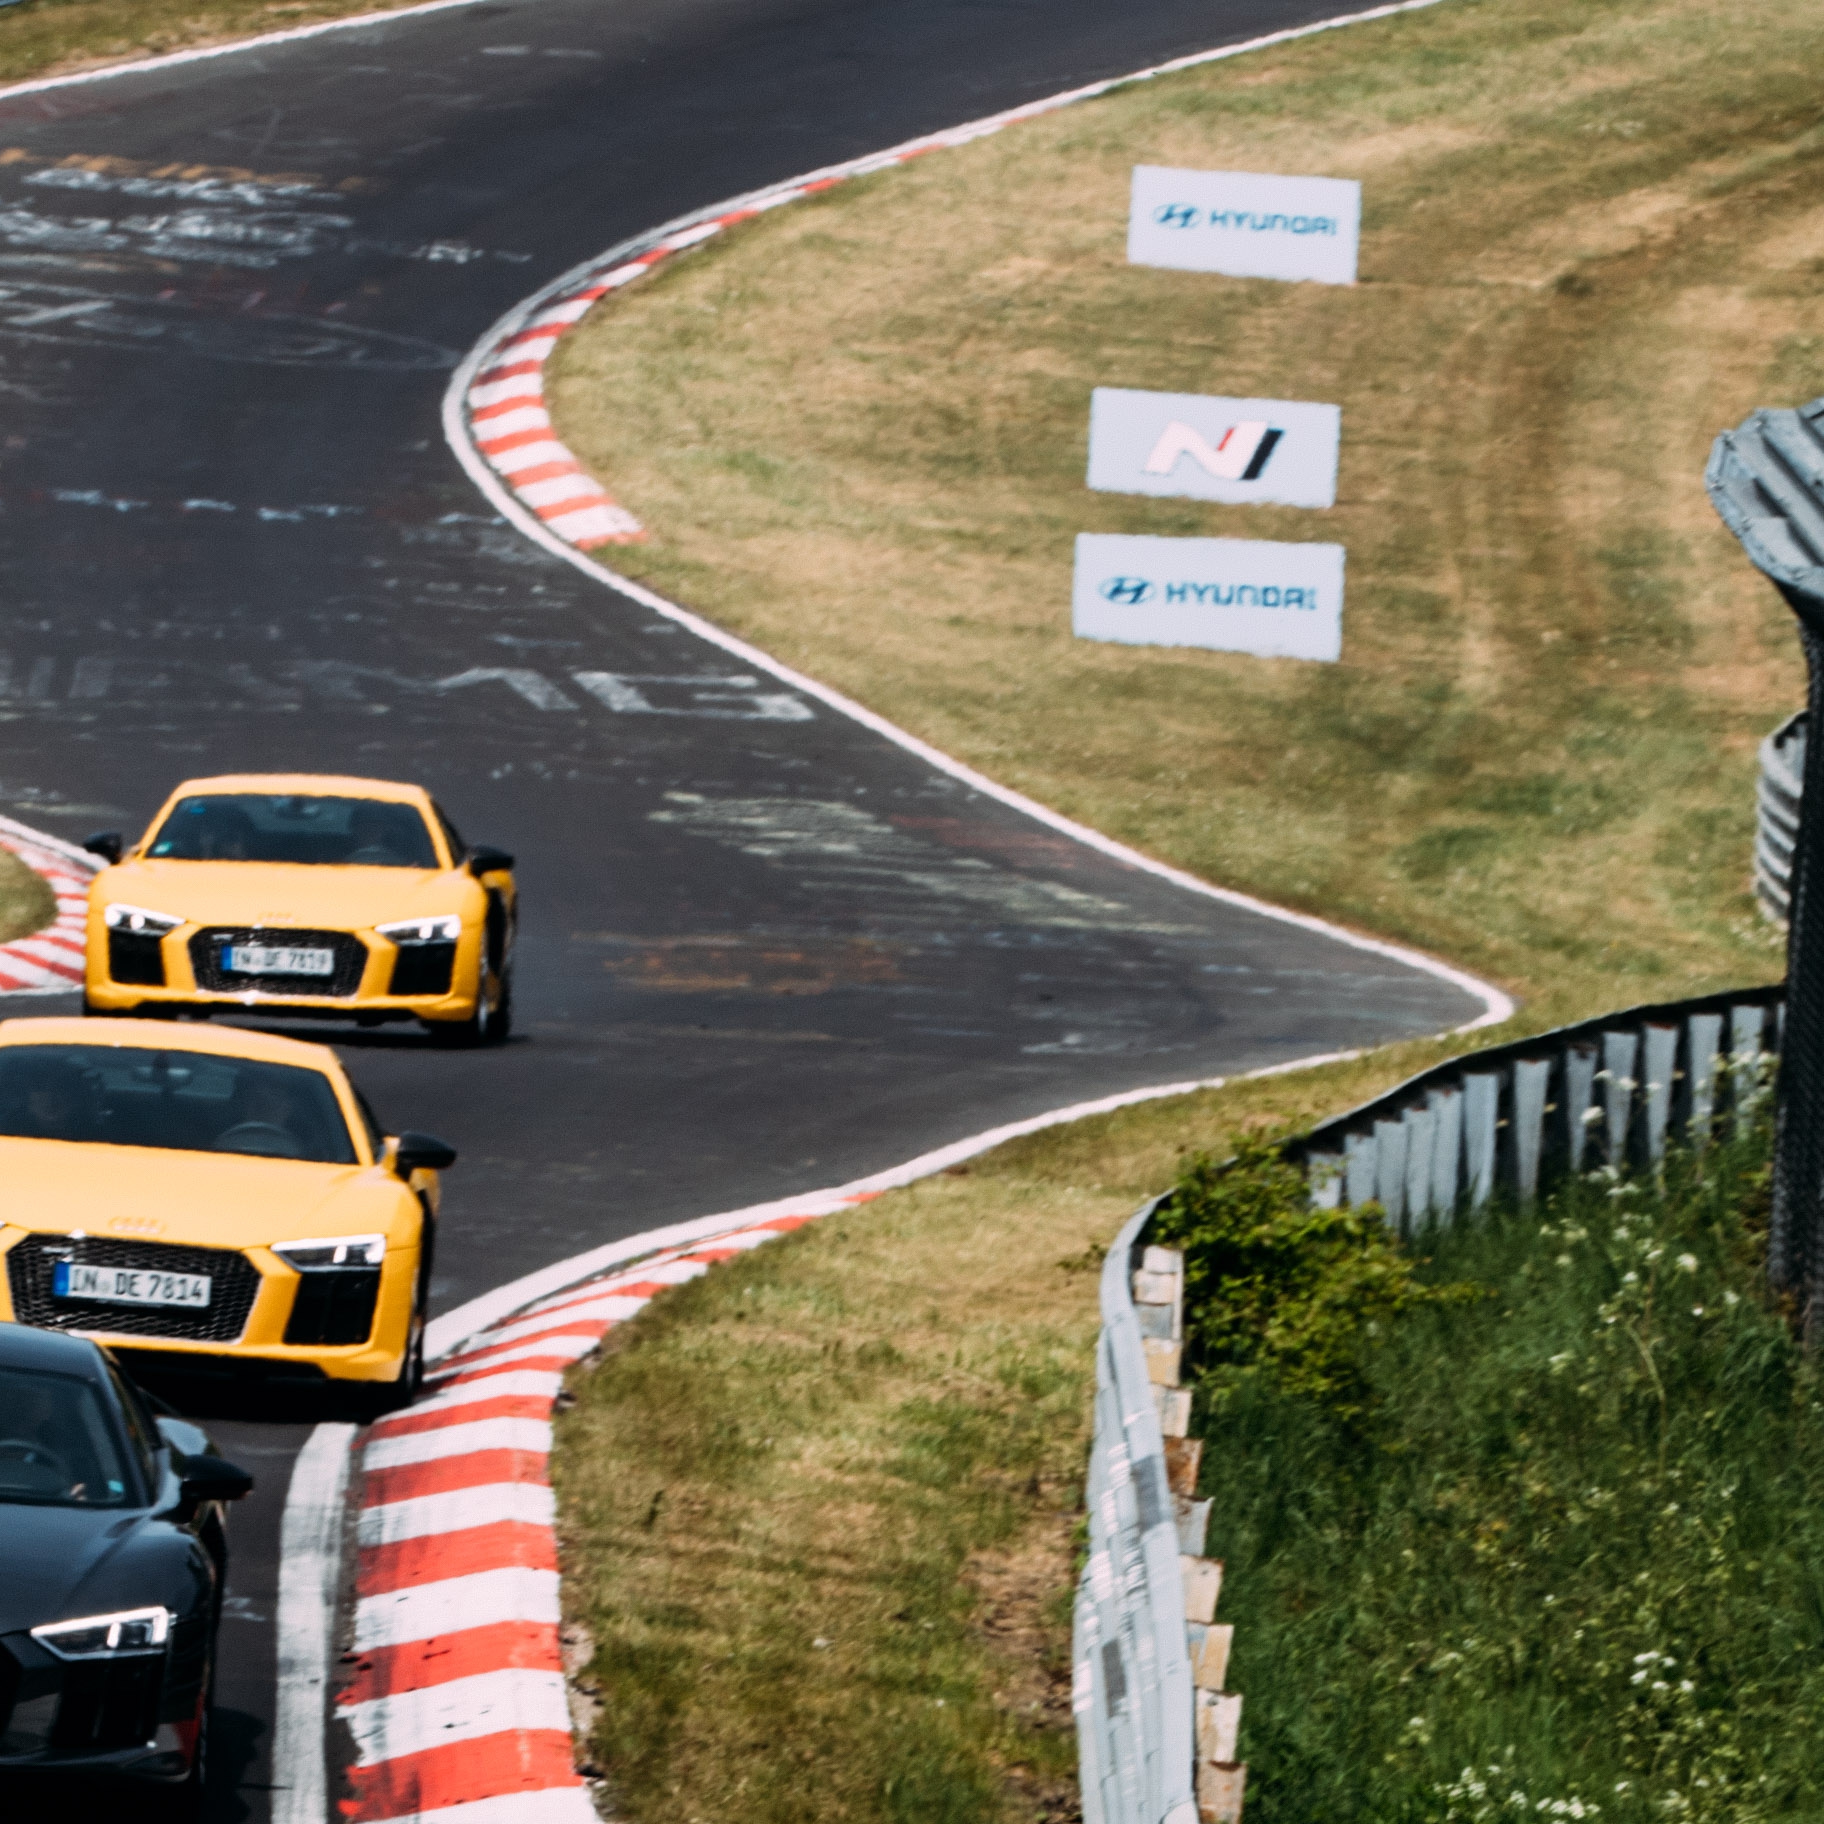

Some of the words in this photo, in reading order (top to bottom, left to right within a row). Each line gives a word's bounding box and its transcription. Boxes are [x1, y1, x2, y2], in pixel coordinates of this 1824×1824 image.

[1209, 208, 1337, 237] HYUNDAI
[1165, 582, 1317, 611] HYUNDAI
[72, 1268, 98, 1292] IN
[115, 1272, 142, 1297] DE
[148, 1275, 204, 1301] 7814
